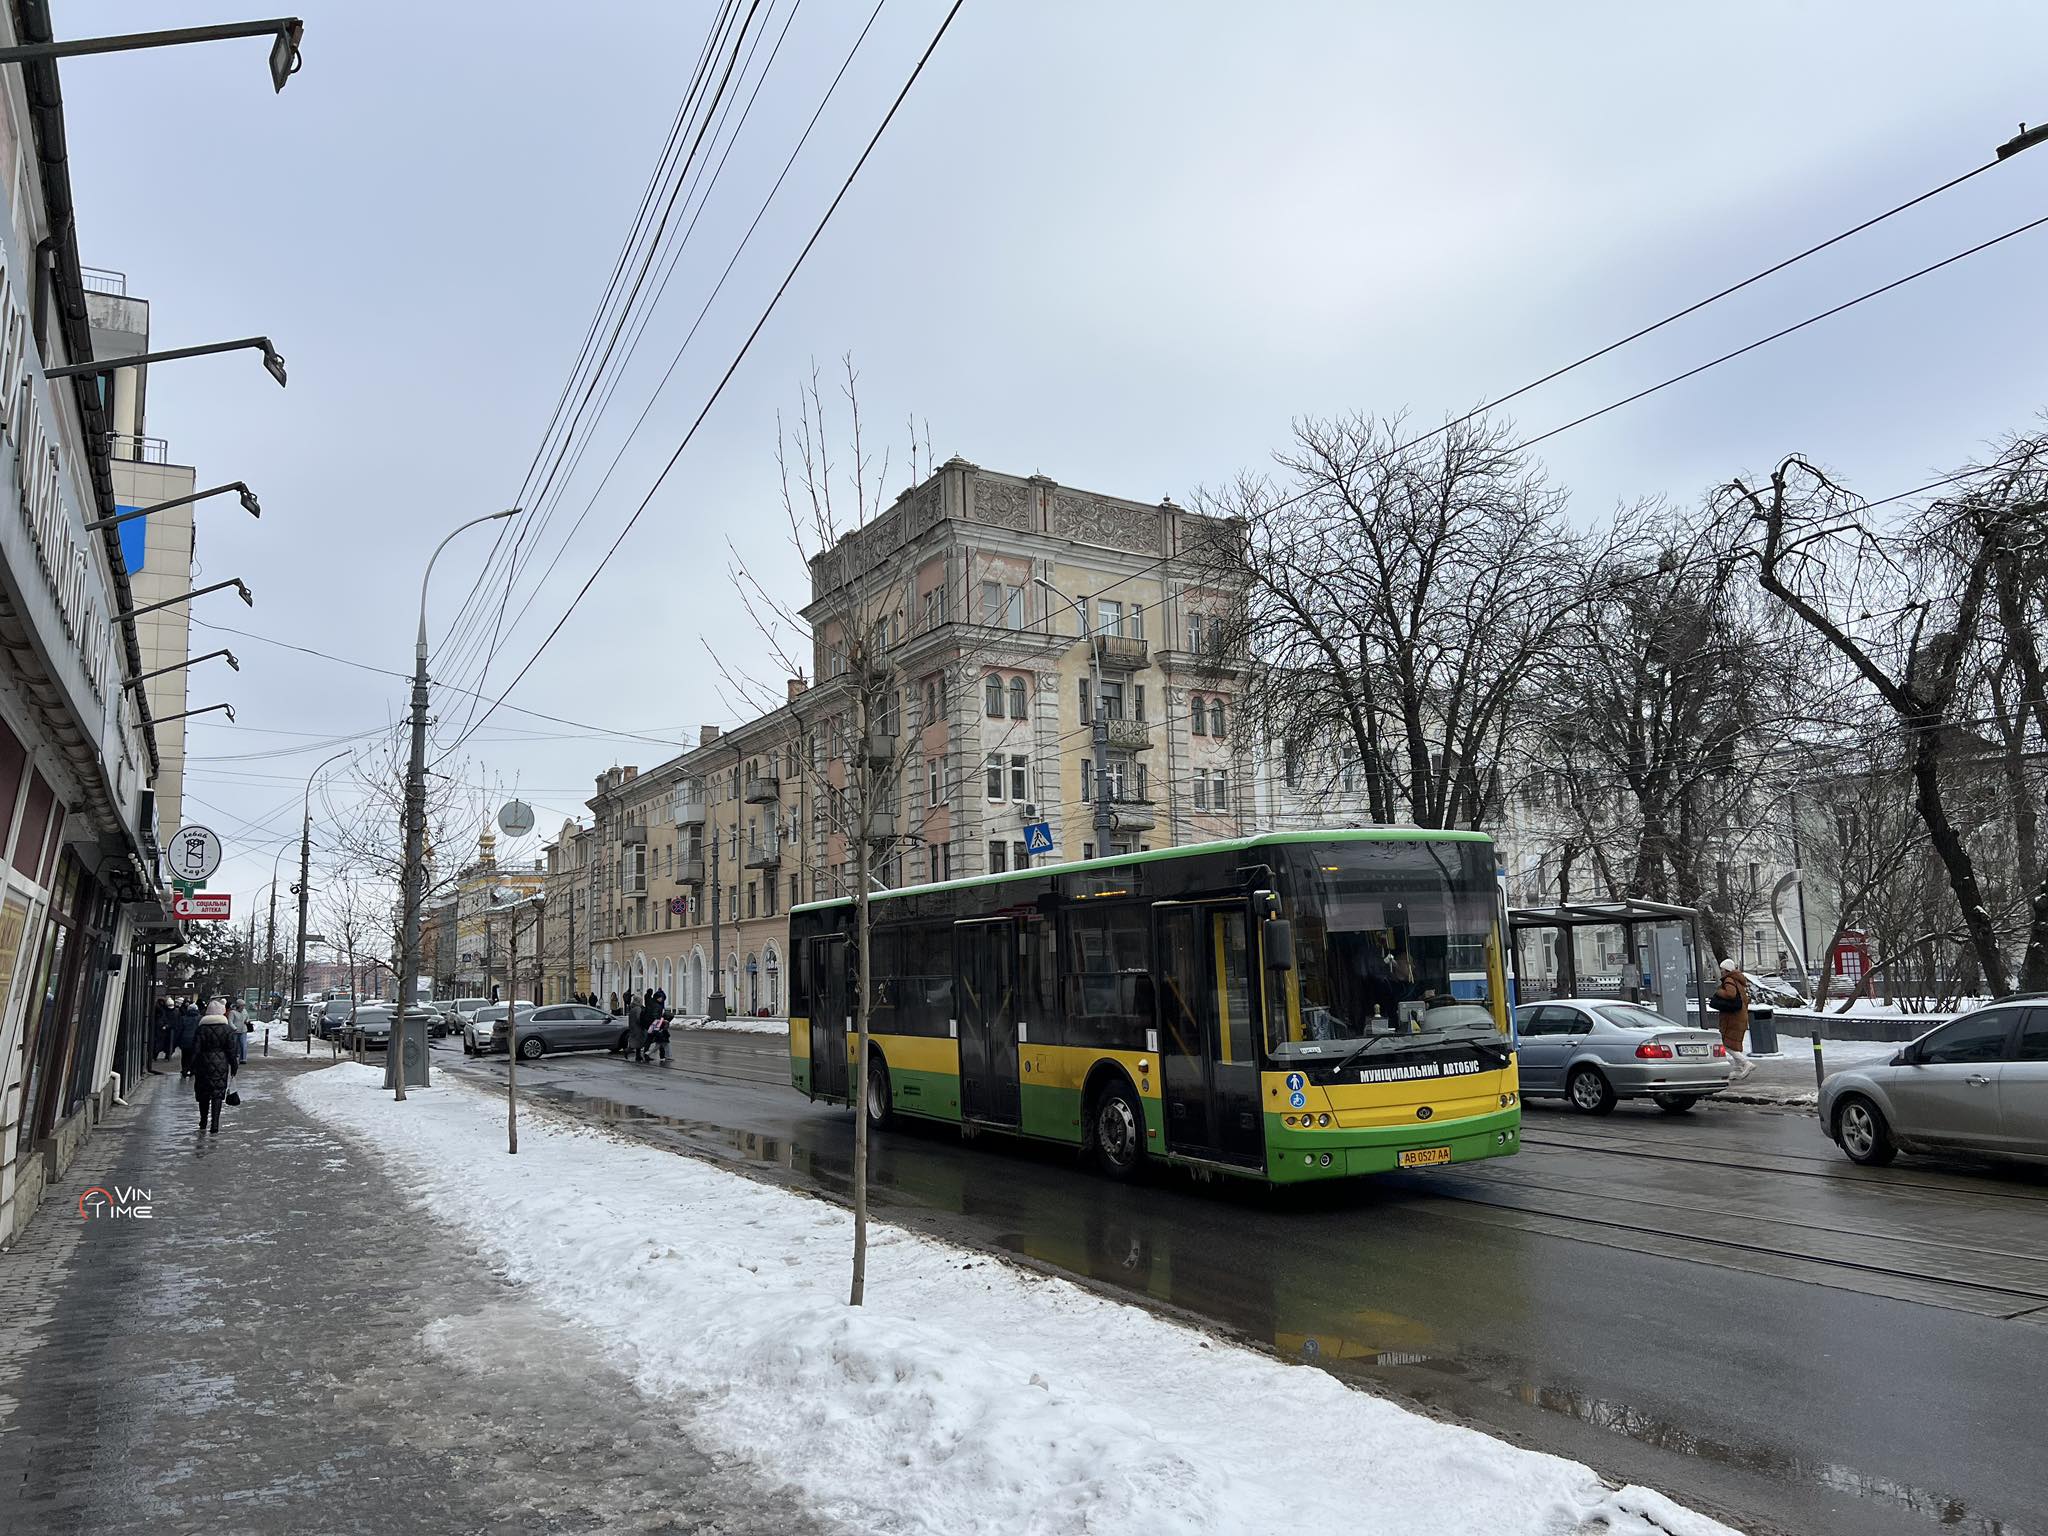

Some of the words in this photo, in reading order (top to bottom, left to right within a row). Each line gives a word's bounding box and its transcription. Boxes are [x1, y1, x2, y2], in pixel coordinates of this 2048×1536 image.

[19, 373, 88, 649] УКРАЇНСЬКОЇ
[181, 901, 189, 912] 1
[1360, 1062, 1440, 1083] МУНІЦИПАЛЬНИЙ
[1443, 1060, 1480, 1075] АВТОБУС
[1418, 1150, 1436, 1162] 0527
[1438, 1149, 1449, 1160] AA
